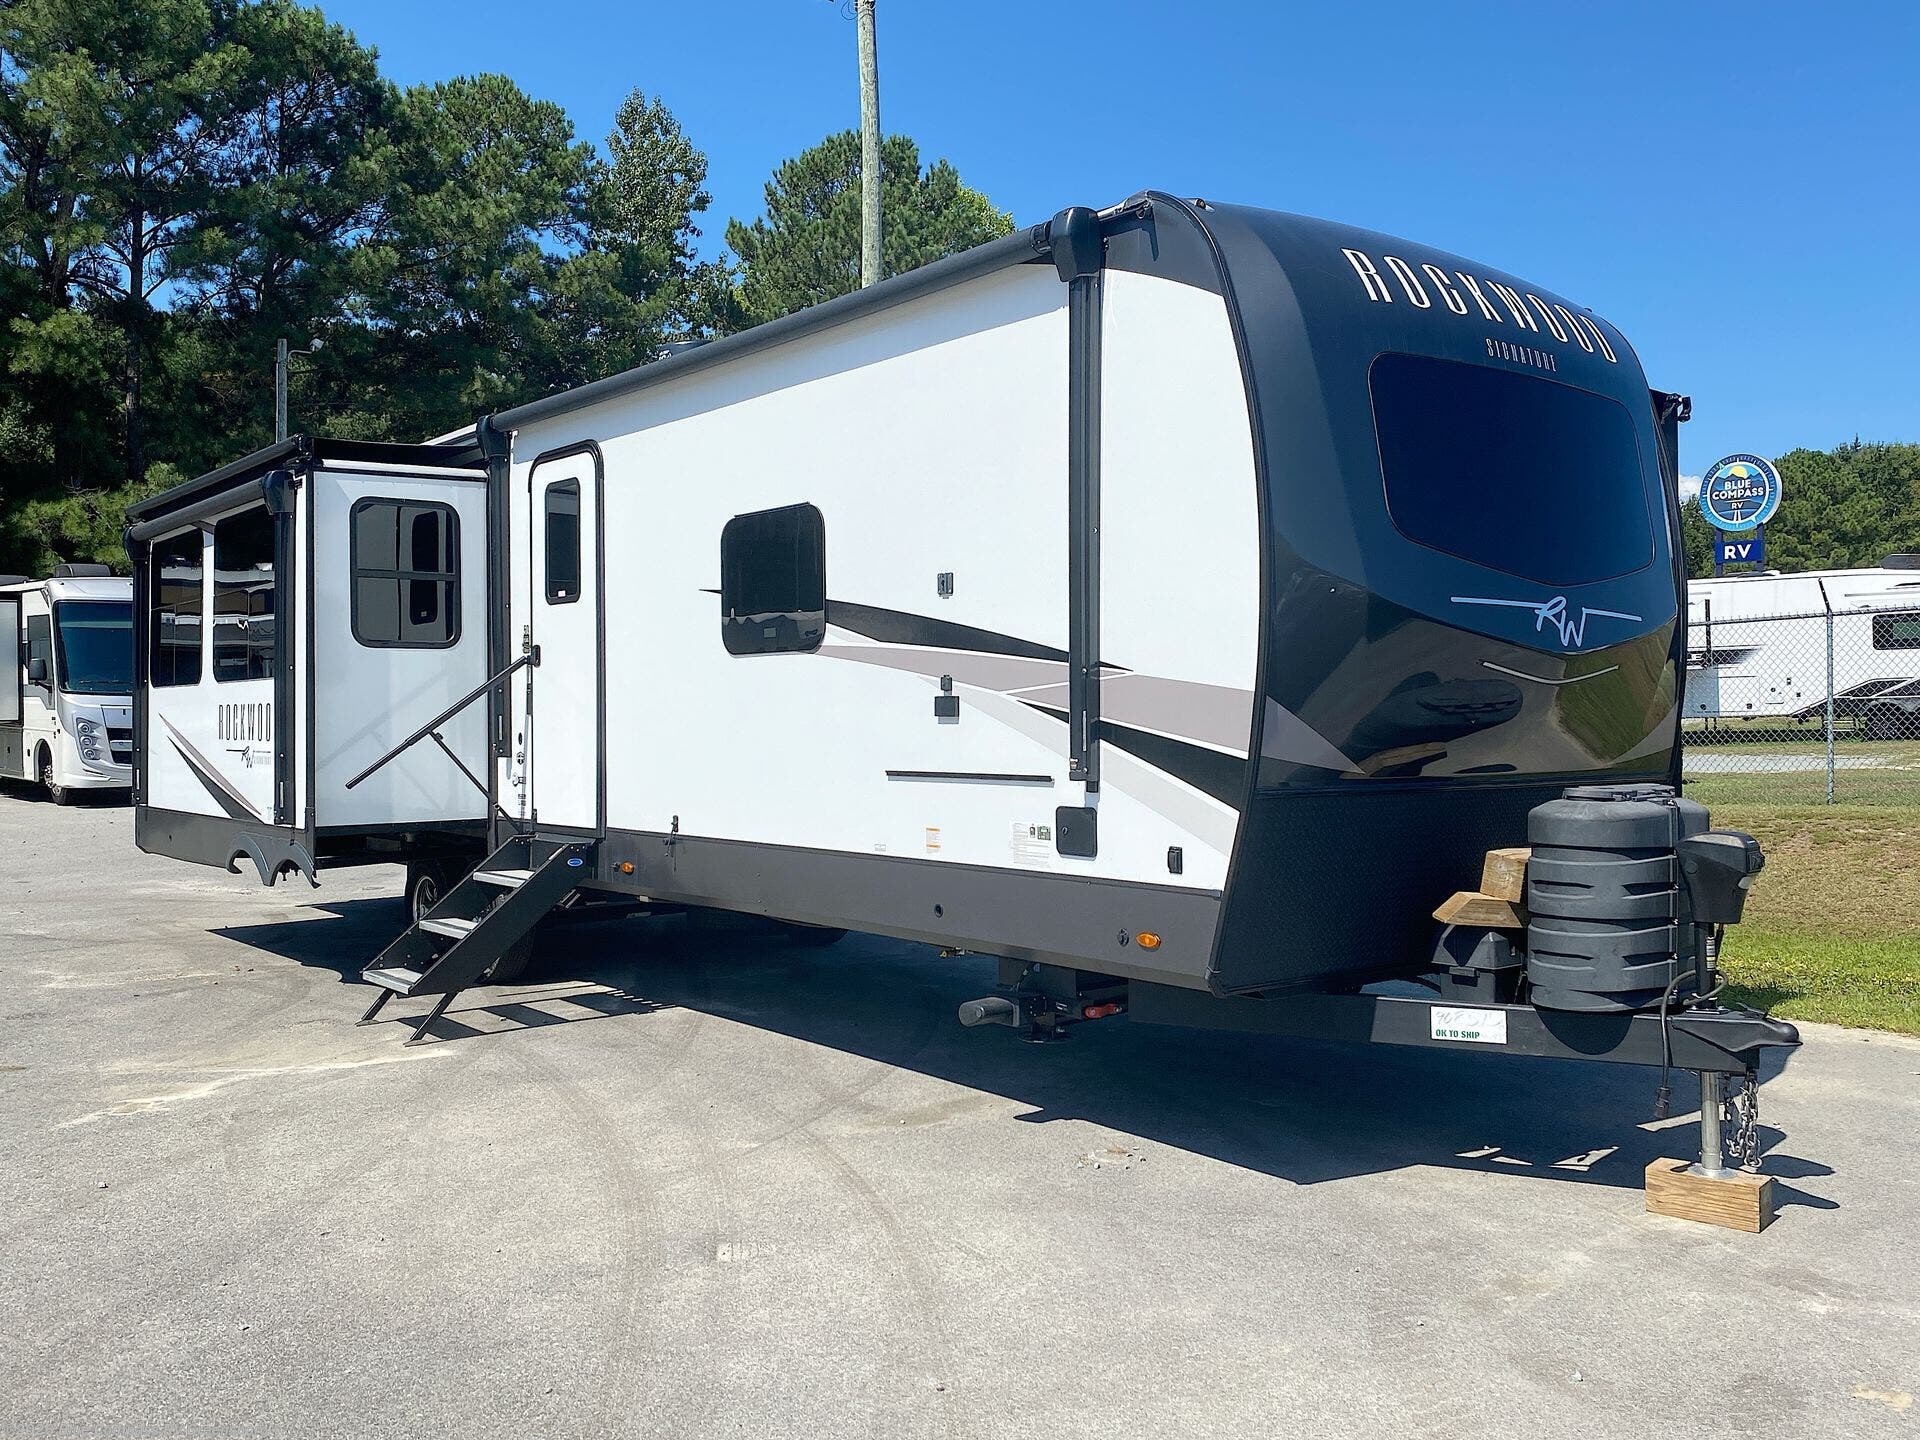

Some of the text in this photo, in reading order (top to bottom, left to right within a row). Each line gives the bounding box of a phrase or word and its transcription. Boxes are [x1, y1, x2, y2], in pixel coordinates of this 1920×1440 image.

[1341, 247, 1618, 364] ROCKWOOD
[1485, 337, 1557, 373] SIGNATURE
[1724, 479, 1751, 490] BLUE
[1712, 487, 1764, 500] COMPASS
[1731, 502, 1744, 510] RV
[1724, 543, 1752, 560] RV
[218, 703, 271, 741] ROCKWOO
[1435, 1028, 1480, 1039] OK TO SHIP
